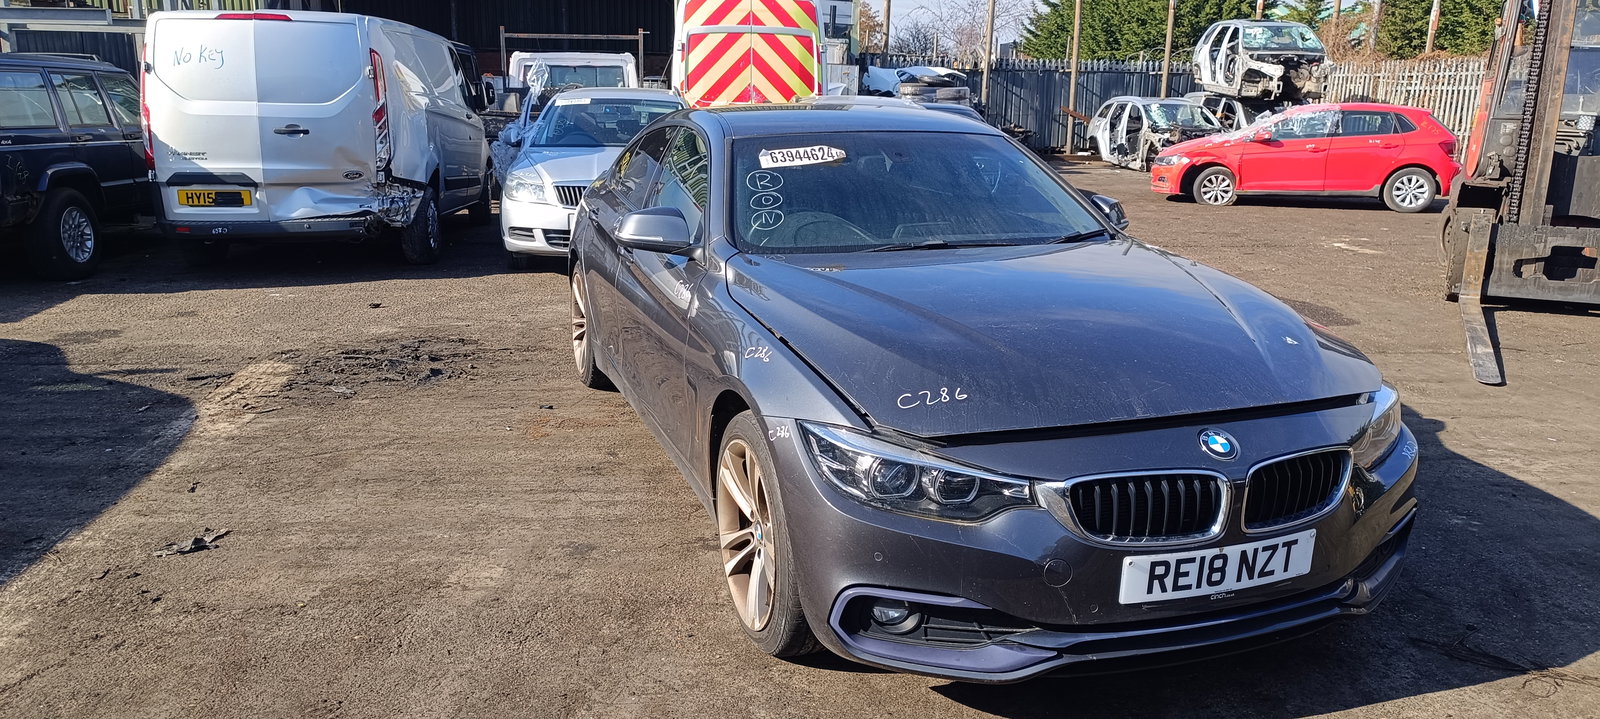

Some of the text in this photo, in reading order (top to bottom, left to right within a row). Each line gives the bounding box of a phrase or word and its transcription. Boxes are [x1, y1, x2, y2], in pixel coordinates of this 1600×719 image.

[173, 46, 192, 67] No
[770, 147, 835, 163] 63944624
[185, 192, 214, 204] HY15
[744, 346, 773, 362] C286
[897, 387, 968, 408] C286
[1146, 538, 1299, 595] RE18 NZT
